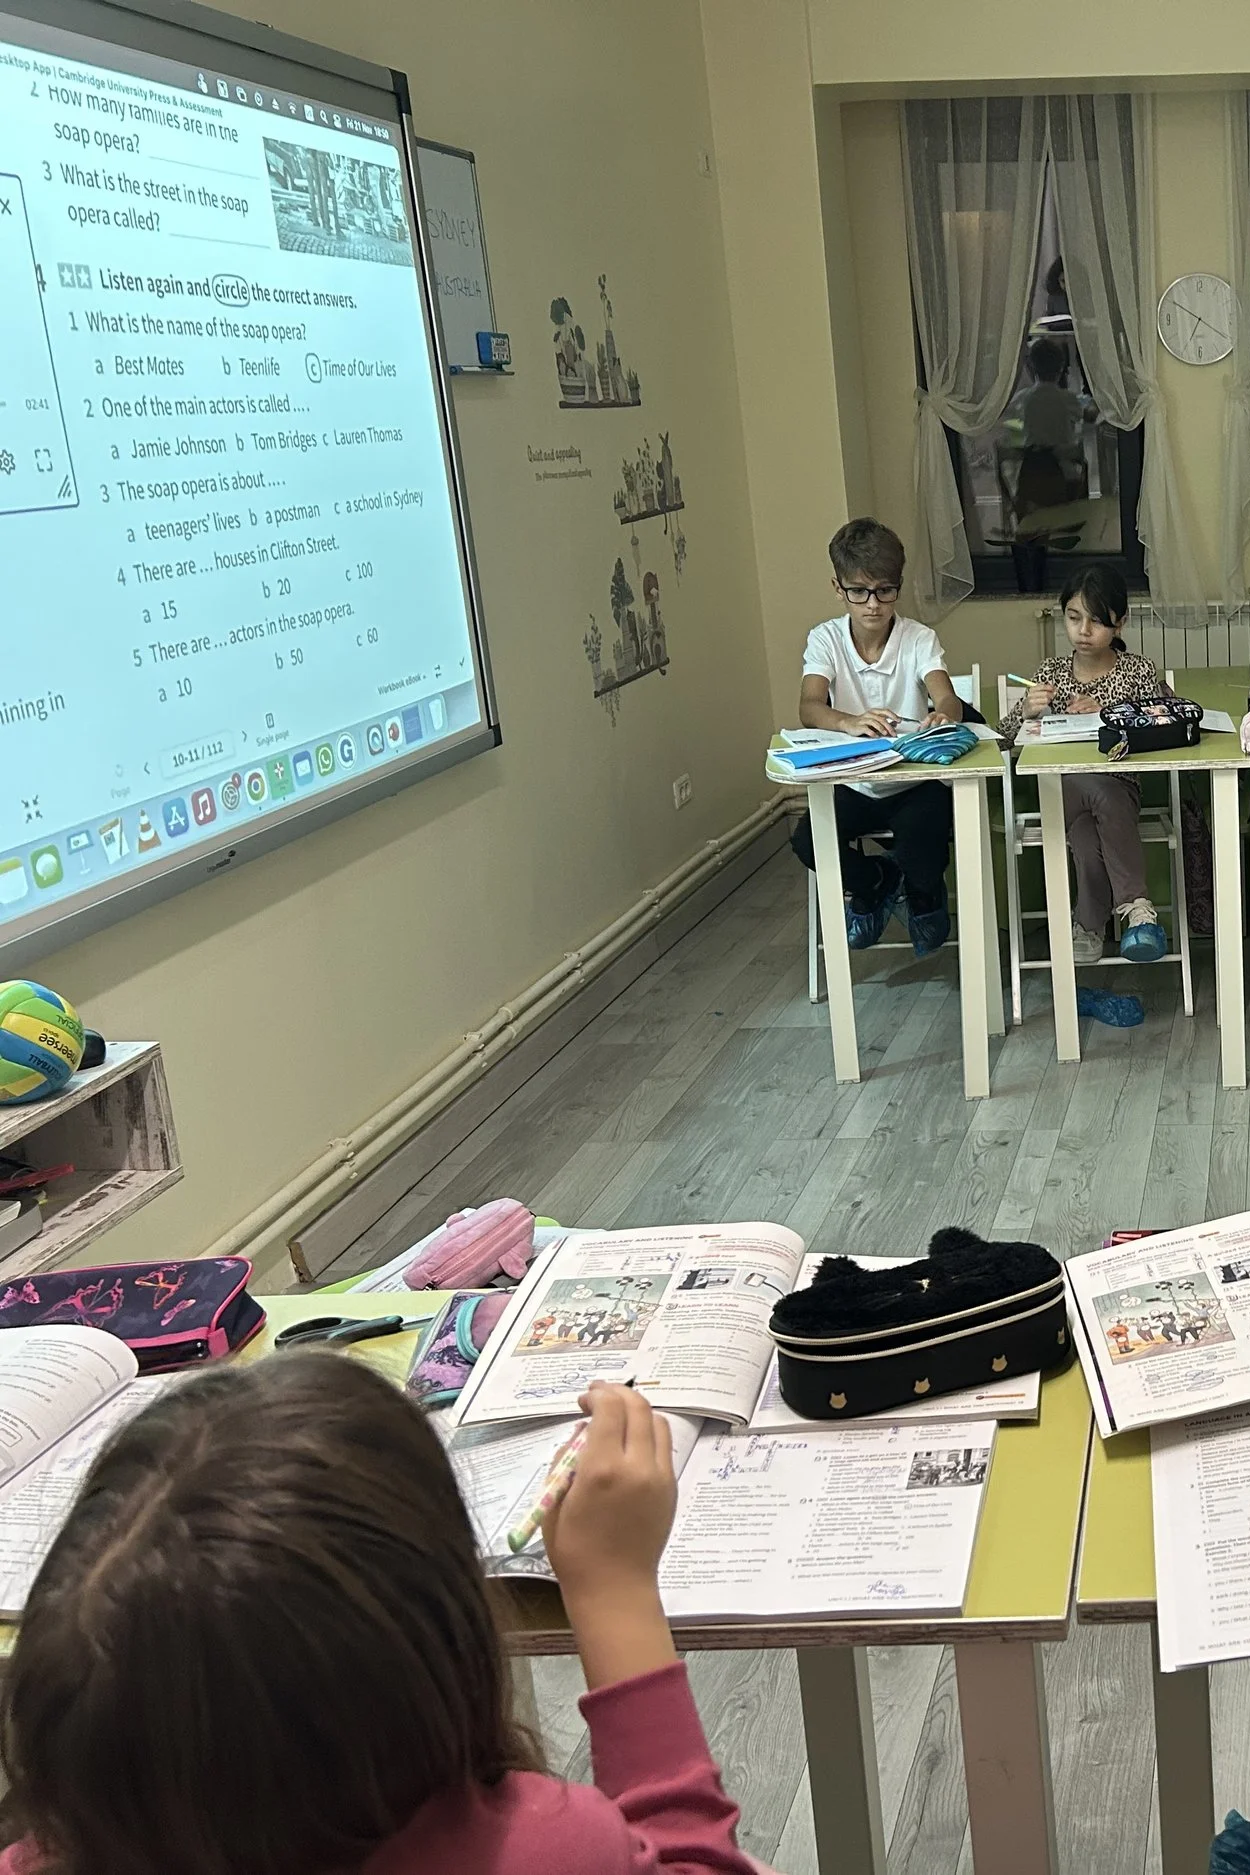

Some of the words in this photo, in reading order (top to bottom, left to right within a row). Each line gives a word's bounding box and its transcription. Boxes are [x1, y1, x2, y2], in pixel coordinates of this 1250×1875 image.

[33, 60, 51, 76] App
[58, 67, 105, 90] Cambridge
[106, 78, 147, 101] University
[149, 89, 171, 105] Press
[179, 97, 223, 118] Assessment
[48, 84, 83, 104] How
[87, 94, 125, 121] many
[183, 115, 203, 134] are
[53, 122, 90, 148] soap
[94, 129, 141, 154] opera?
[42, 160, 52, 182] 3
[60, 162, 101, 190] What
[102, 169, 115, 191] is
[118, 173, 141, 195] the
[143, 179, 182, 203] street
[182, 183, 196, 205] in
[198, 187, 218, 208] the
[221, 194, 249, 218] soap
[67, 204, 111, 228] opera
[113, 207, 161, 232] called?
[426, 208, 476, 249] SYDNEY
[99, 268, 144, 292] Listen
[147, 274, 184, 299] again
[187, 278, 211, 297] and
[214, 278, 248, 301] circle
[251, 282, 271, 302] the
[273, 289, 311, 306] correct
[313, 291, 357, 309] answers.
[68, 311, 78, 331] 1
[85, 310, 126, 333] What
[126, 312, 140, 334] is
[141, 313, 164, 335] the
[167, 319, 203, 337] name
[206, 316, 218, 338] of
[220, 316, 240, 338] the
[242, 323, 269, 343] soap
[271, 323, 307, 343] opera?
[95, 358, 104, 375] a
[115, 355, 144, 376] Best
[146, 356, 185, 376] Mates
[222, 356, 231, 375] b
[239, 356, 280, 376] Teenlife
[323, 359, 346, 377] Time
[347, 358, 357, 376] of
[358, 360, 375, 377] Our
[376, 360, 396, 377] Lives
[25, 399, 49, 411] 02:41
[84, 398, 94, 418] 2
[102, 397, 132, 418] One
[134, 394, 147, 416] of
[150, 396, 172, 416] the
[175, 396, 207, 415] main
[210, 398, 246, 415] actors
[246, 395, 256, 413] is
[111, 444, 120, 460] a
[131, 437, 171, 459] Jamie
[174, 435, 227, 456] Johnson
[235, 433, 245, 451] b
[251, 432, 277, 451] Tom
[279, 430, 318, 453] Bridges
[322, 433, 329, 446] c
[333, 429, 367, 446] Lauren
[367, 426, 403, 442] Thomas
[100, 484, 110, 503] 3
[117, 479, 145, 501] The
[147, 481, 179, 502] soap
[181, 479, 218, 500] opera
[218, 472, 230, 492] is
[126, 528, 136, 543] a
[212, 512, 241, 532] lives
[248, 508, 257, 526] b
[265, 509, 273, 525] a
[275, 503, 321, 528] postman
[334, 501, 341, 515] c
[346, 499, 352, 512] a
[353, 492, 383, 513] school
[382, 492, 393, 509] in
[393, 489, 424, 510] Sydney
[117, 567, 126, 587] 4
[133, 562, 173, 584] There
[175, 559, 197, 577] are
[214, 551, 257, 571] houses
[257, 544, 269, 563] in
[270, 539, 306, 561] Clifton
[306, 533, 340, 554] Street.
[142, 608, 152, 624] a
[161, 600, 178, 620] 15
[262, 581, 271, 599] b
[277, 577, 291, 596] 20
[345, 569, 352, 582] c
[357, 561, 373, 580] 100
[133, 648, 143, 667] 5
[149, 641, 189, 664] There
[191, 635, 211, 654] are
[228, 622, 265, 645] actors
[265, 618, 277, 636] in
[278, 613, 297, 632] the
[298, 609, 322, 629] soap
[324, 602, 355, 624] opera.
[158, 687, 168, 703] a
[177, 677, 193, 698] 10
[275, 652, 284, 670] b
[290, 648, 304, 666] 50
[356, 634, 363, 647] c
[367, 627, 379, 644] 60
[0, 698, 48, 725] ining
[48, 691, 65, 712] in
